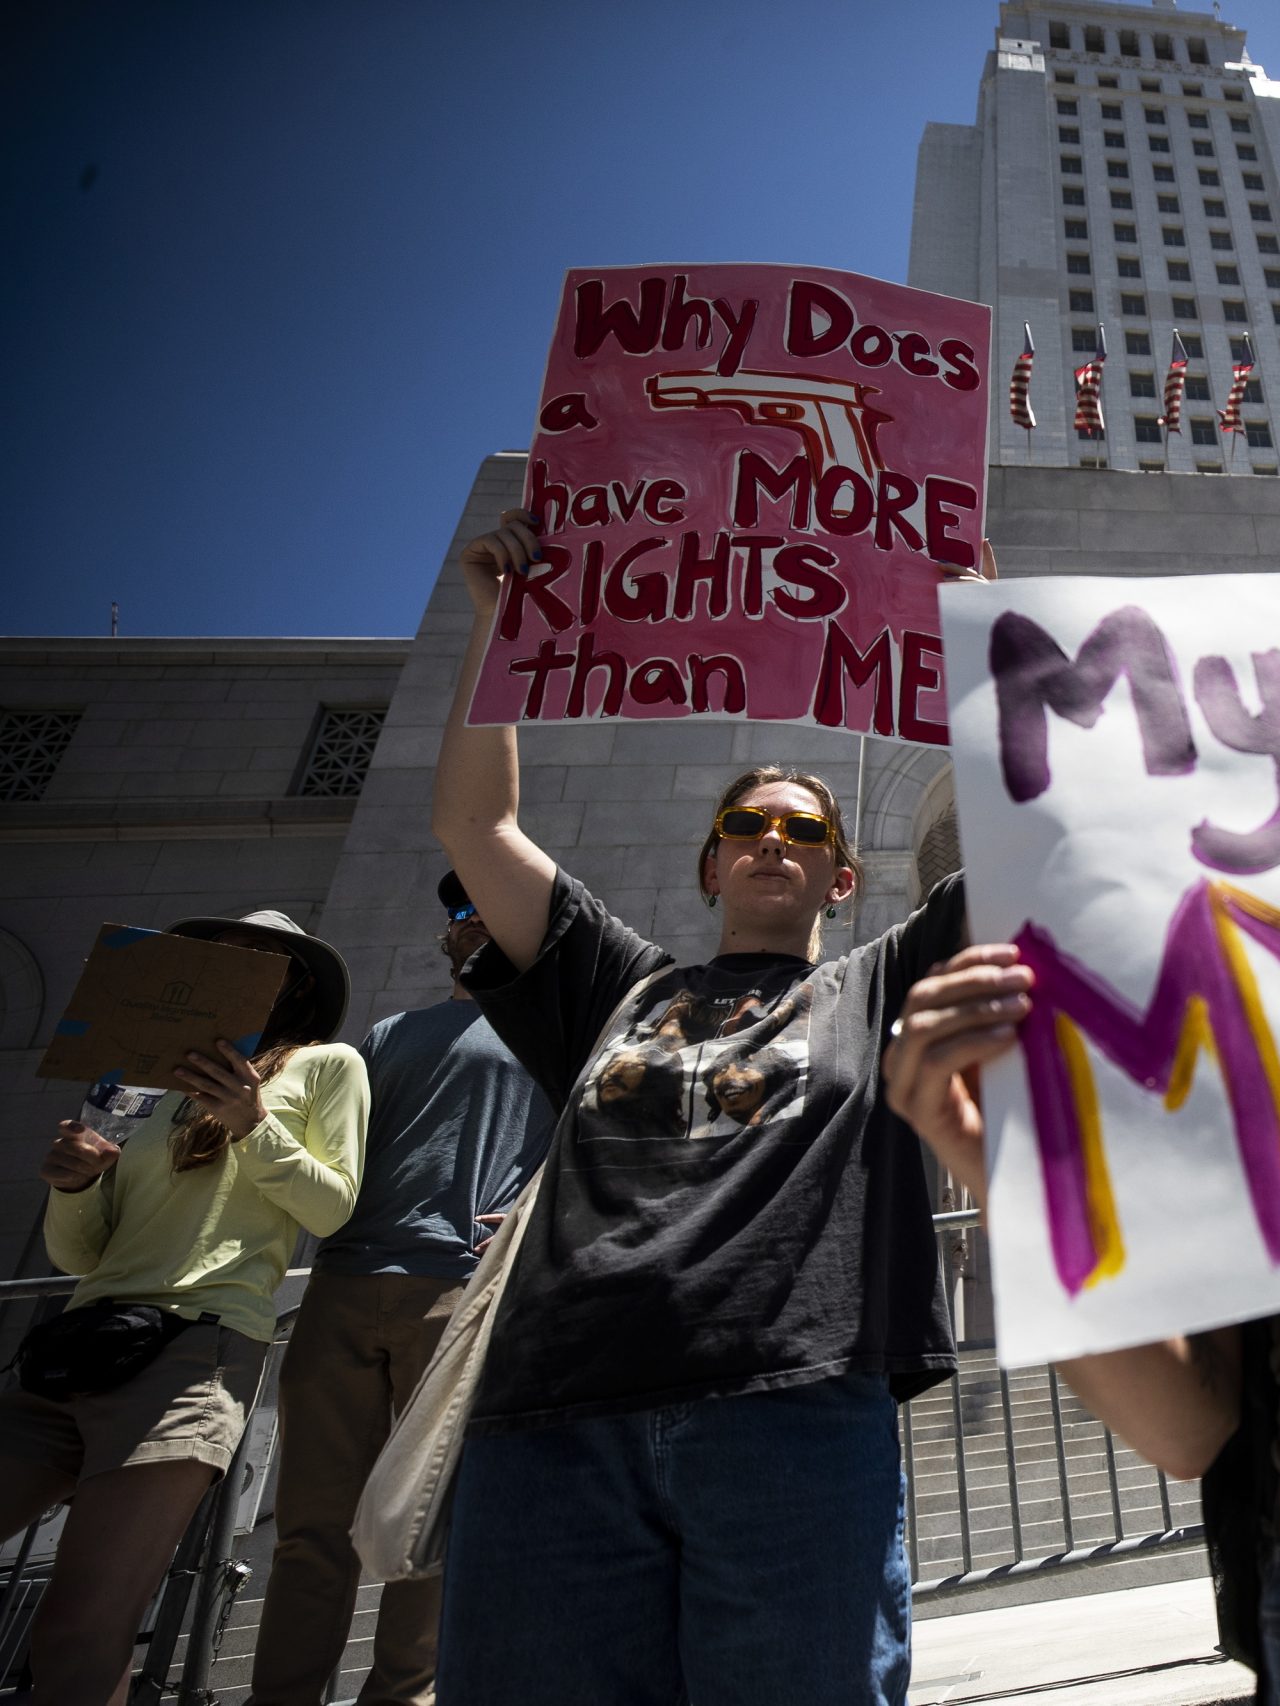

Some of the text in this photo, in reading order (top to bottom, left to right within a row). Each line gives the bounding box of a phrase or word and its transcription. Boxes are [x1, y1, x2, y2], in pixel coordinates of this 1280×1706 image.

[574, 273, 981, 391] Why Does
[539, 393, 599, 432] a
[532, 449, 978, 565] have MORE
[499, 532, 847, 641] RIGHTS
[509, 619, 952, 745] than ME
